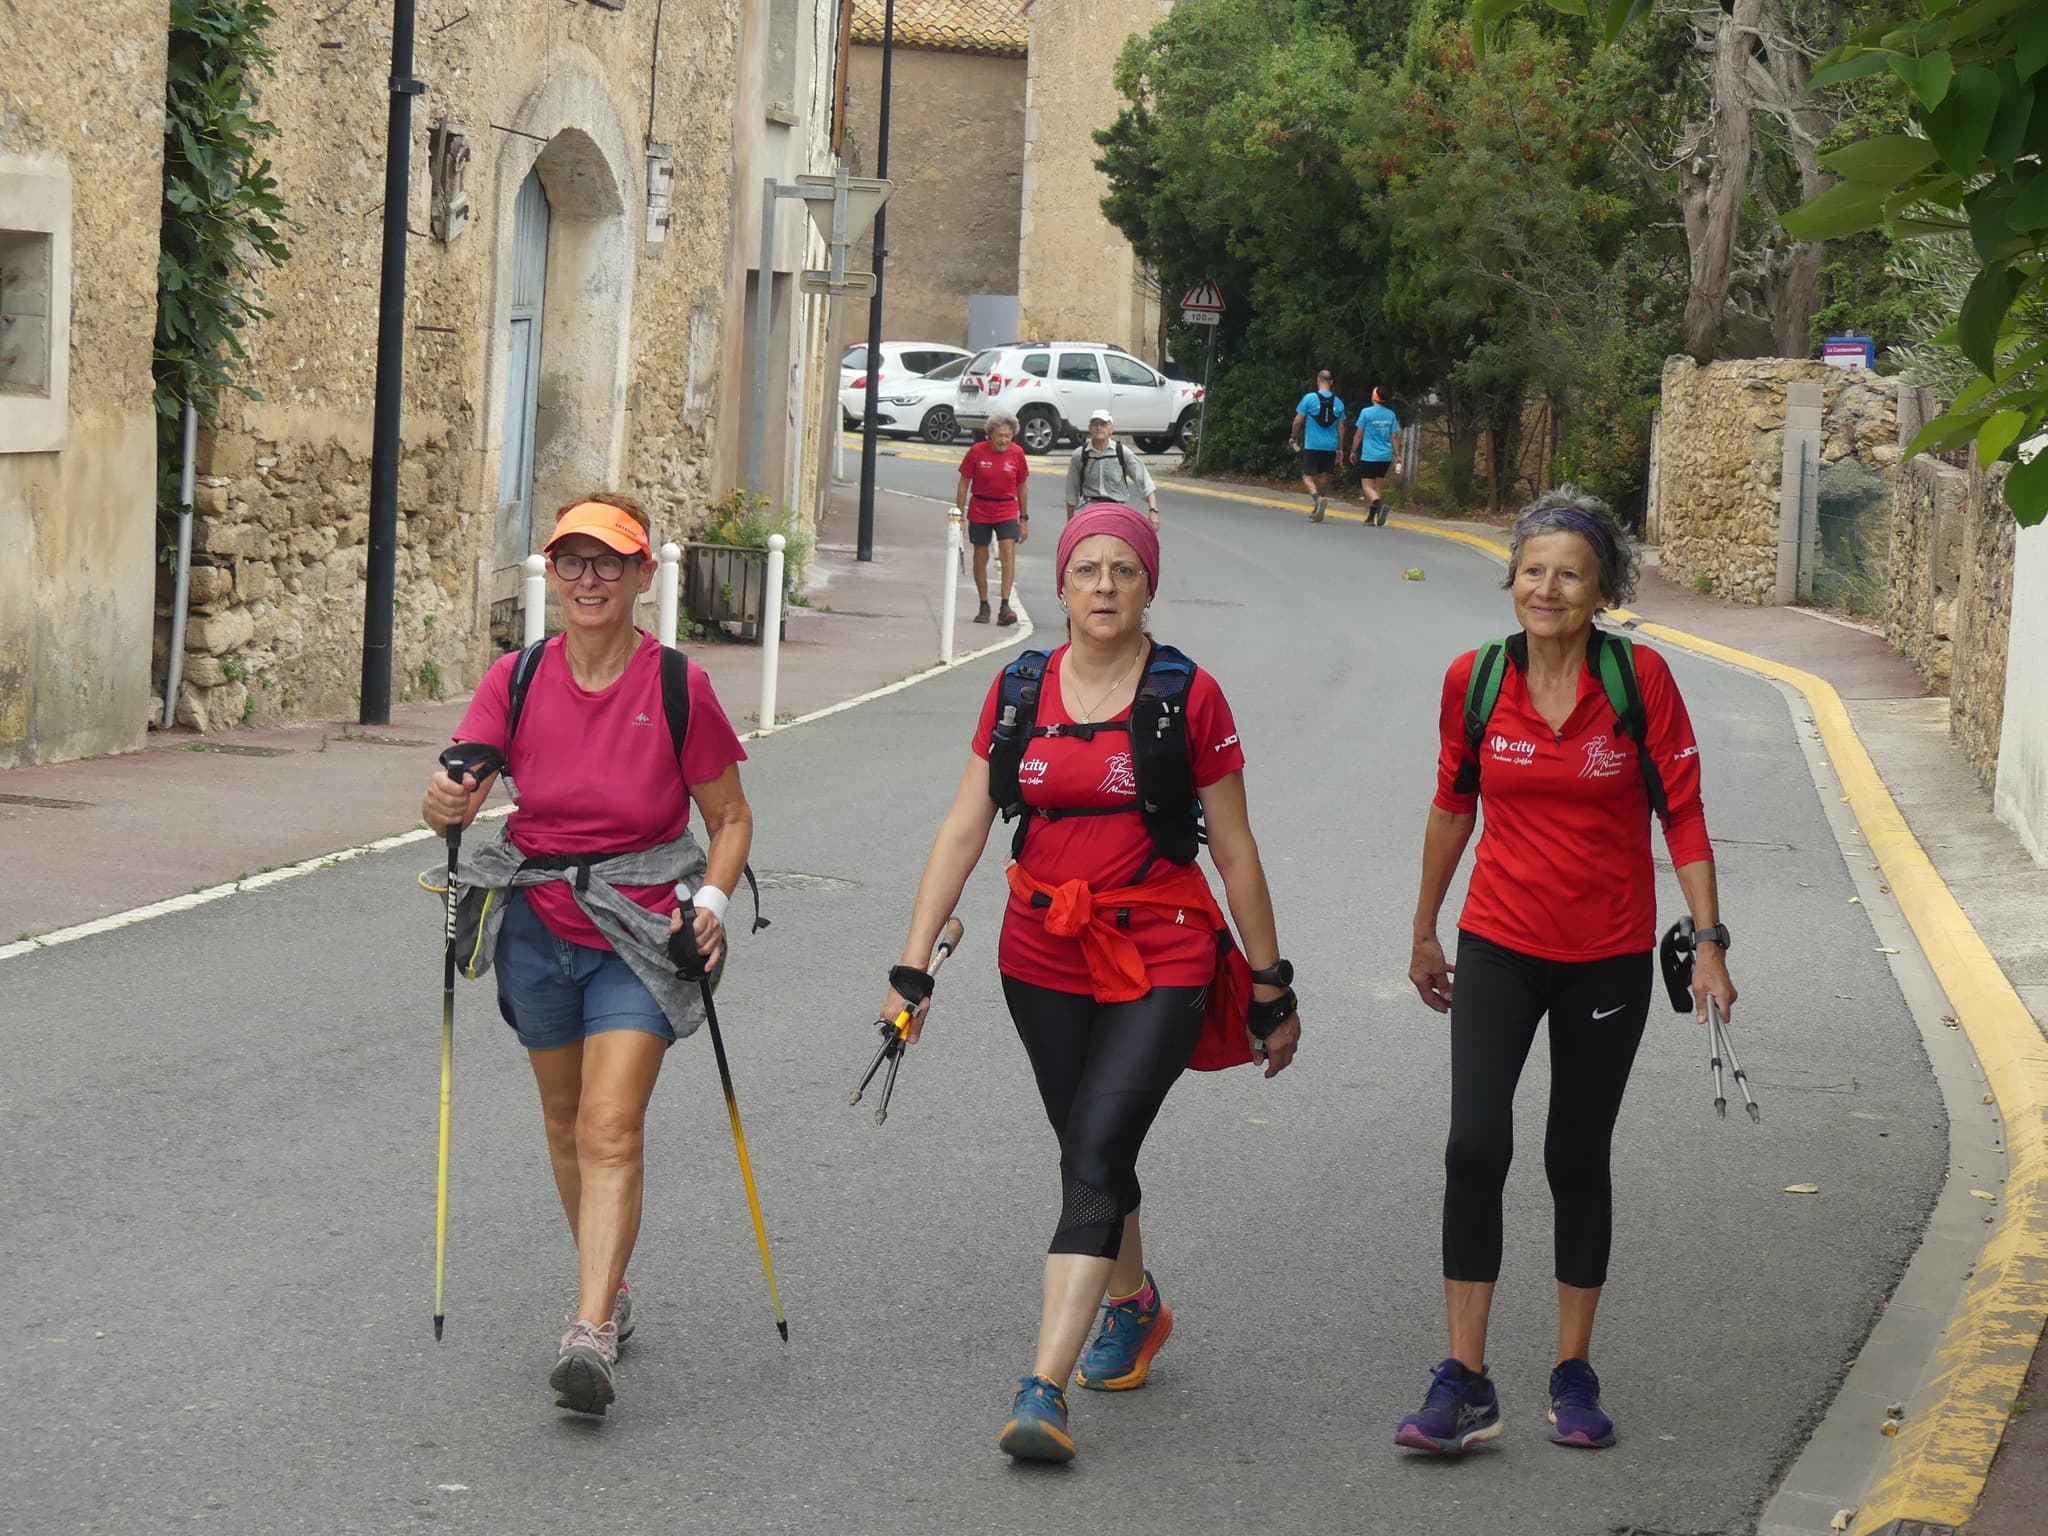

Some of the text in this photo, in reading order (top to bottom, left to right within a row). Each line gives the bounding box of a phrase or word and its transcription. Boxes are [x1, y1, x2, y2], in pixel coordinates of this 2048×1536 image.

[1192, 313, 1207, 321] 100
[1509, 740, 1536, 758] city
[1024, 758, 1048, 777] city
